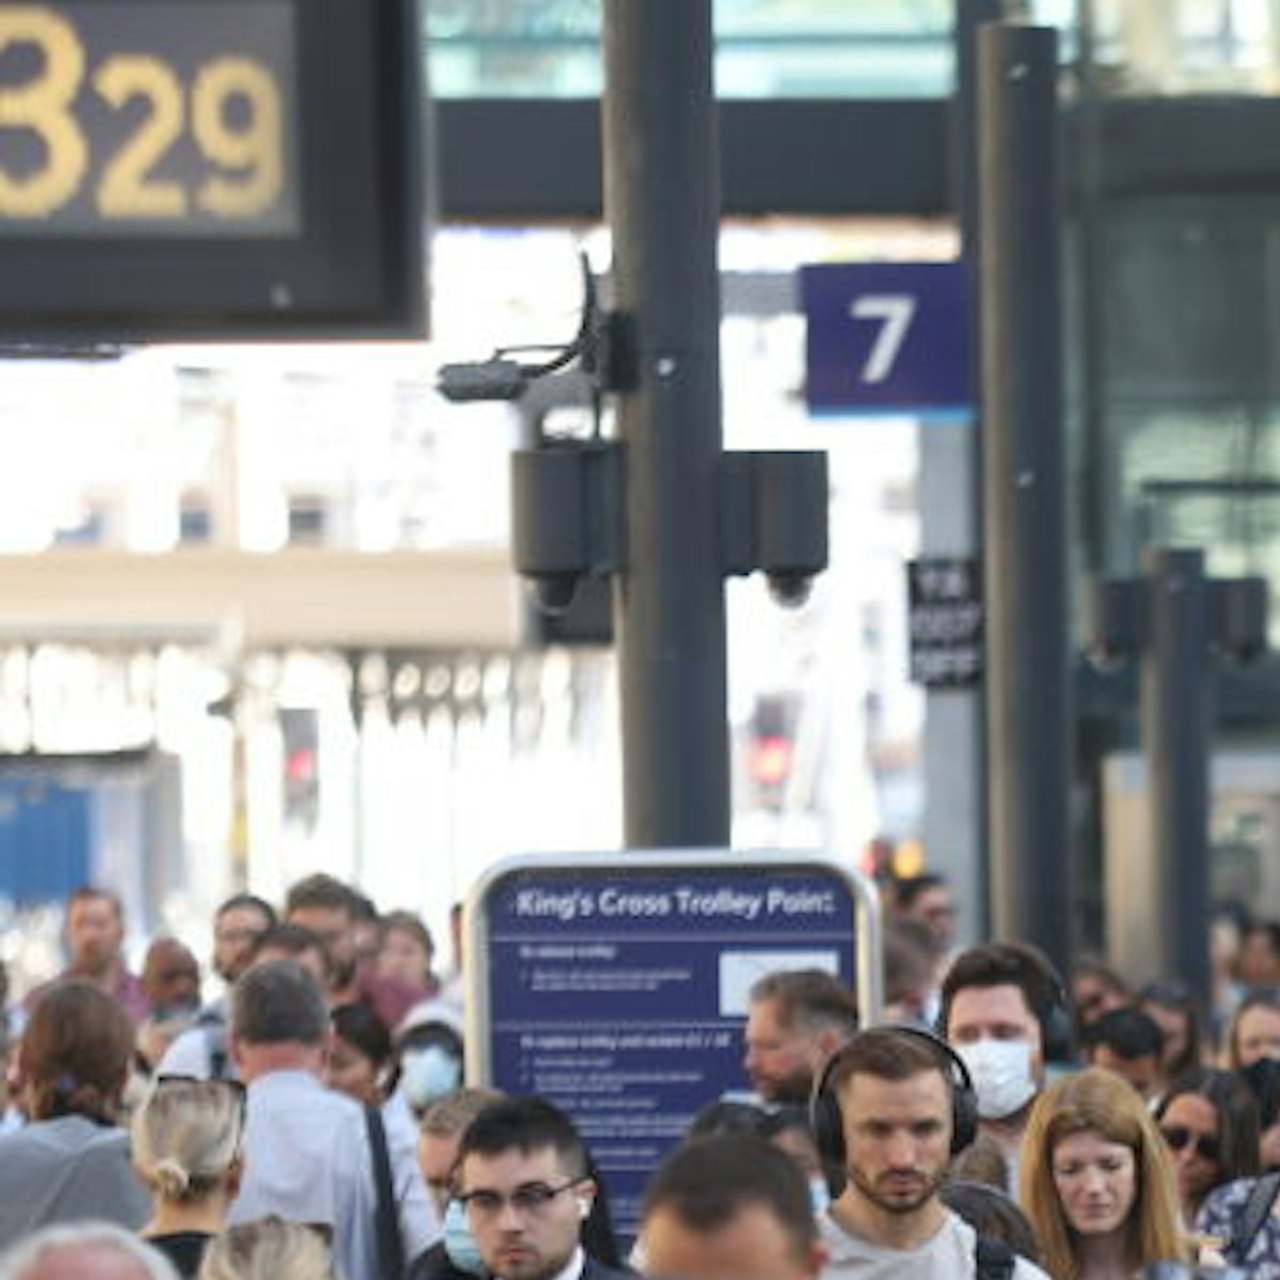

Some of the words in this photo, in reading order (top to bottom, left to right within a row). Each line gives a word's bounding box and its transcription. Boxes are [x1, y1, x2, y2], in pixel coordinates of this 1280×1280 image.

[850, 295, 916, 384] 7
[515, 888, 595, 920] King's
[598, 888, 671, 916] Cross
[674, 888, 763, 920] Trolley
[767, 888, 836, 915] Point
